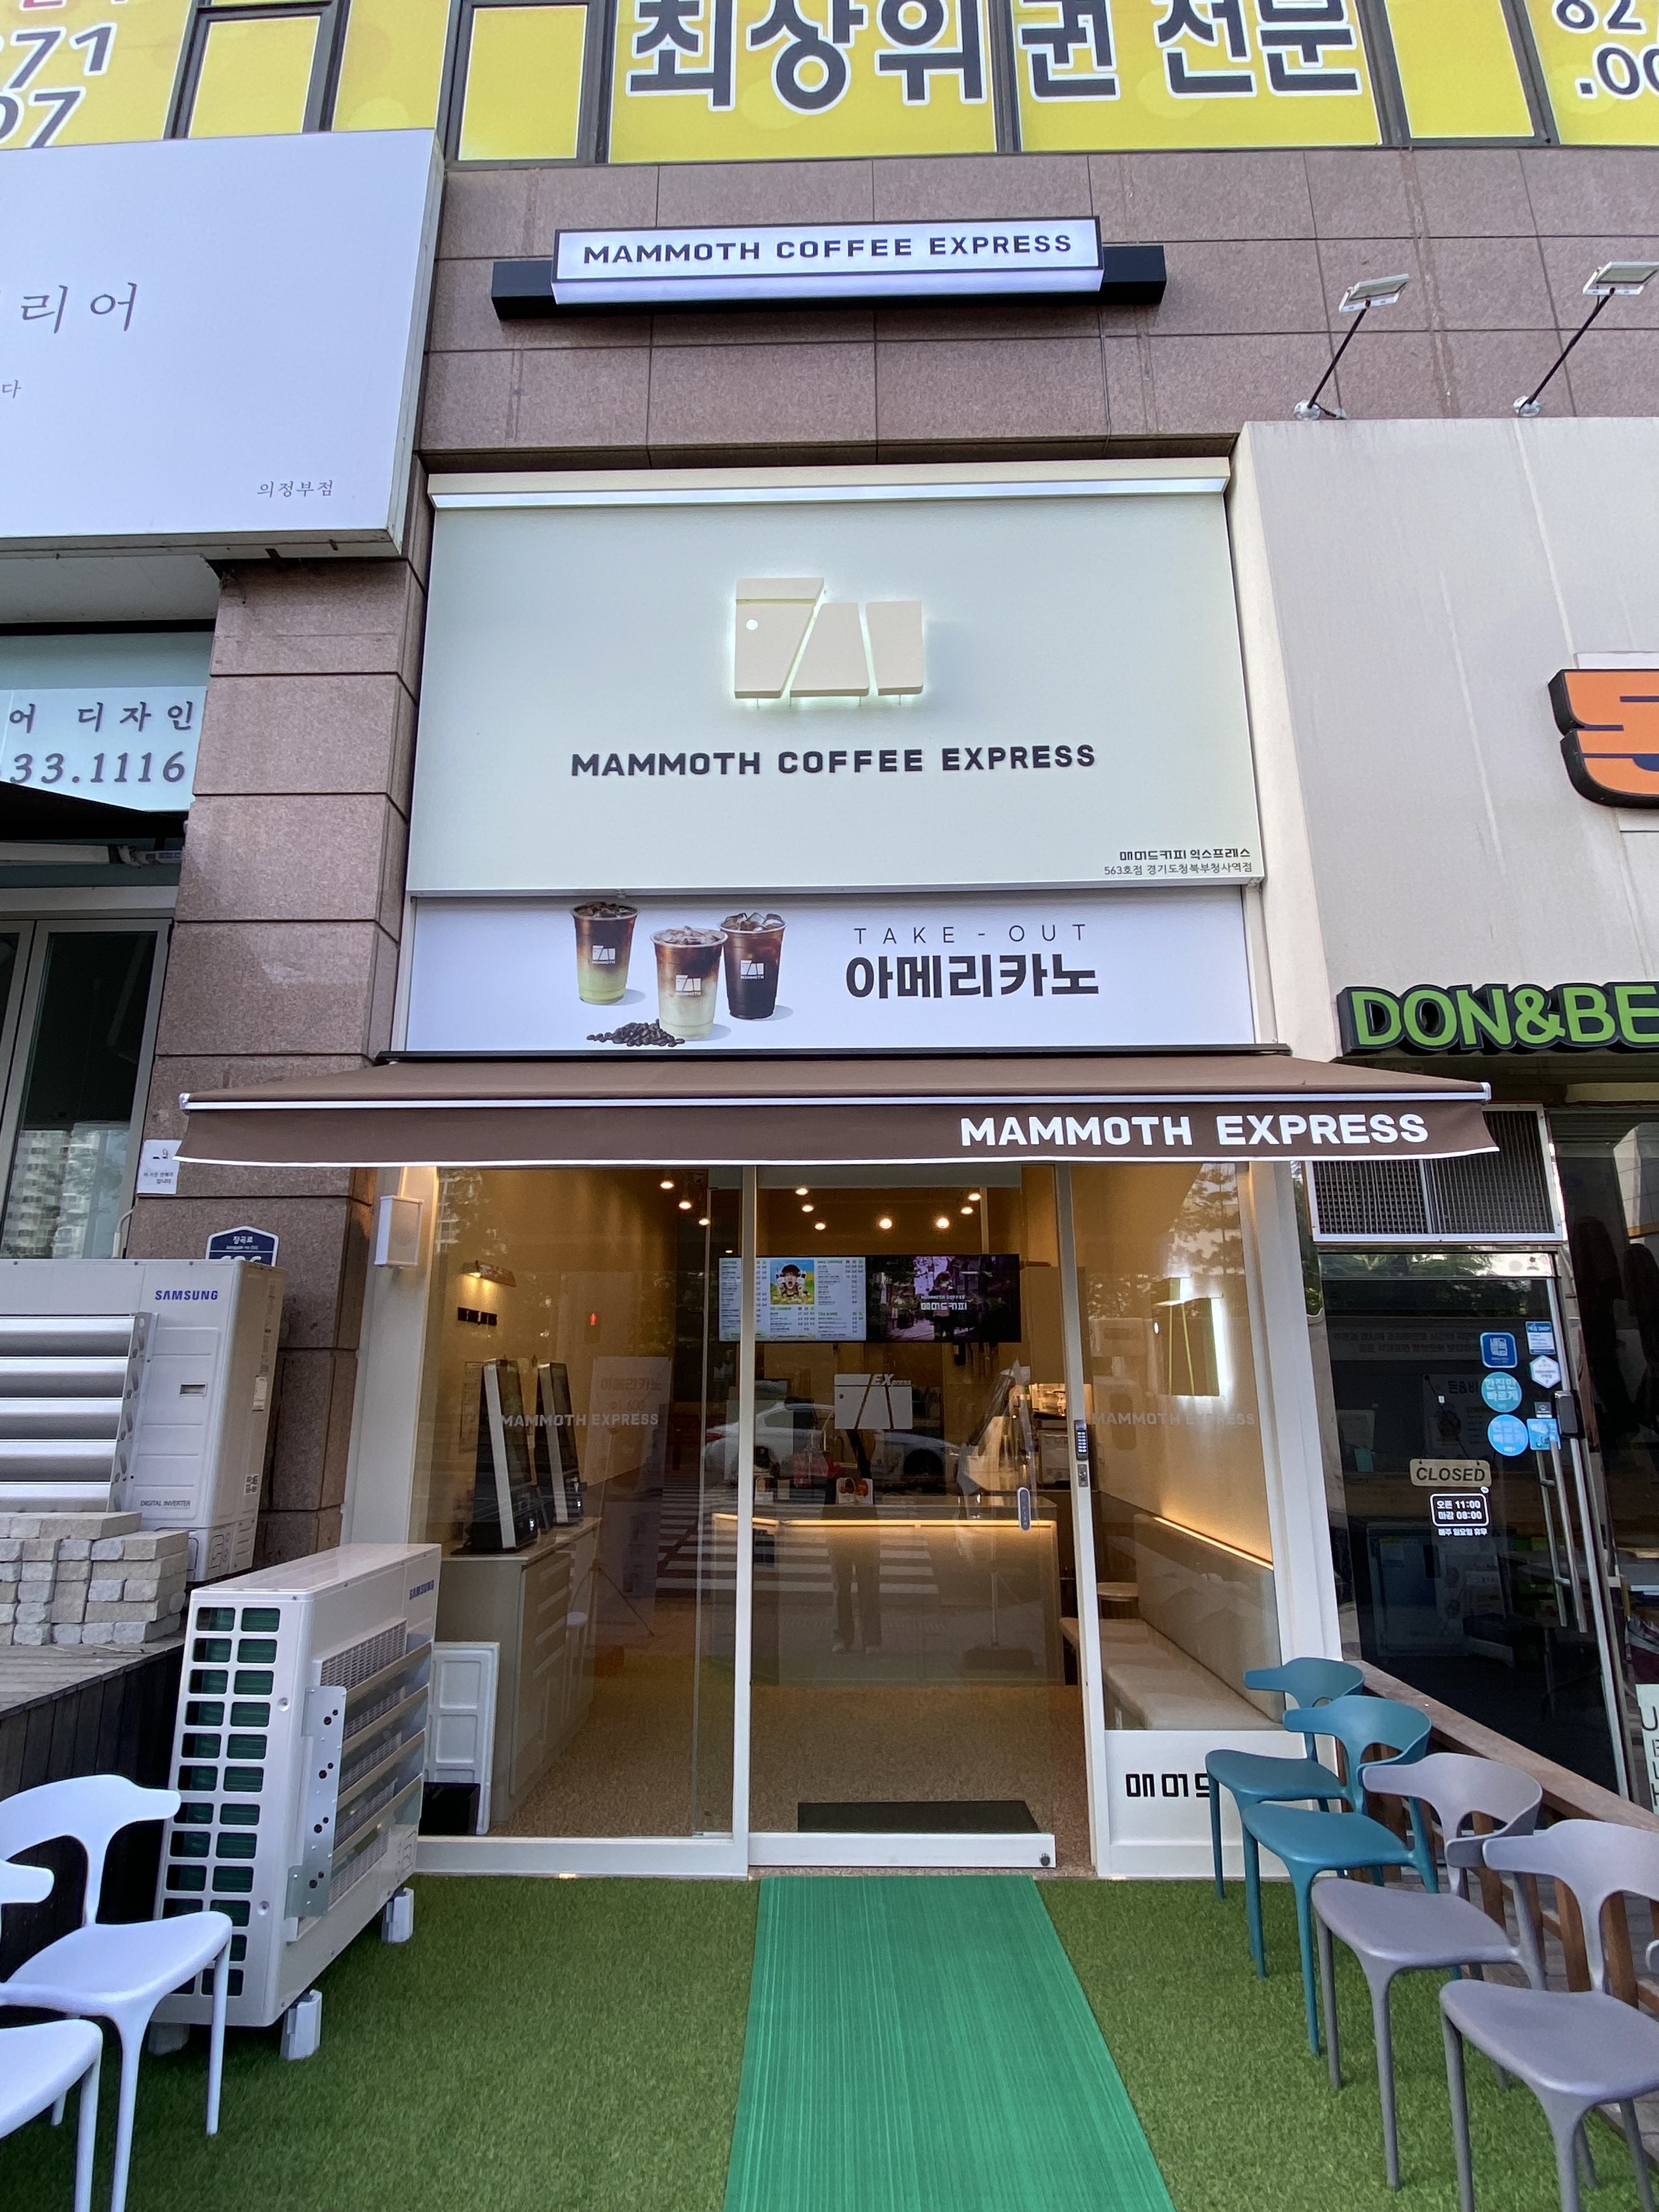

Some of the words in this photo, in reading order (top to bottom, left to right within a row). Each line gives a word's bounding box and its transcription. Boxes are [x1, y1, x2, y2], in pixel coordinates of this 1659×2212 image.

[0, 26, 112, 89] 71
[583, 242, 760, 264] MAMMOTH
[777, 238, 912, 259] COFFEE
[929, 234, 1072, 256] EXPRESS
[257, 479, 334, 498] 의정부점
[77, 701, 193, 732] 디자인
[571, 751, 761, 777] MAMMOTH
[777, 748, 924, 774] COFFEE
[941, 744, 1096, 770] EXPRESS
[1190, 848, 1251, 860] 익스프레스
[1104, 865, 1143, 876] 563호점
[1147, 862, 1252, 875] 경기도청북부청사역점
[845, 953, 1099, 999] 아메리카노
[961, 1116, 1193, 1147] MAMMOTH
[1216, 1114, 1428, 1145] EXPRESS
[155, 1290, 218, 1301] SAMSUNG
[502, 1414, 586, 1426] MAMMOTH
[592, 1413, 658, 1426] EXPRESS
[1417, 1467, 1485, 1481] CLOSED
[1455, 1500, 1481, 1509] 11:00
